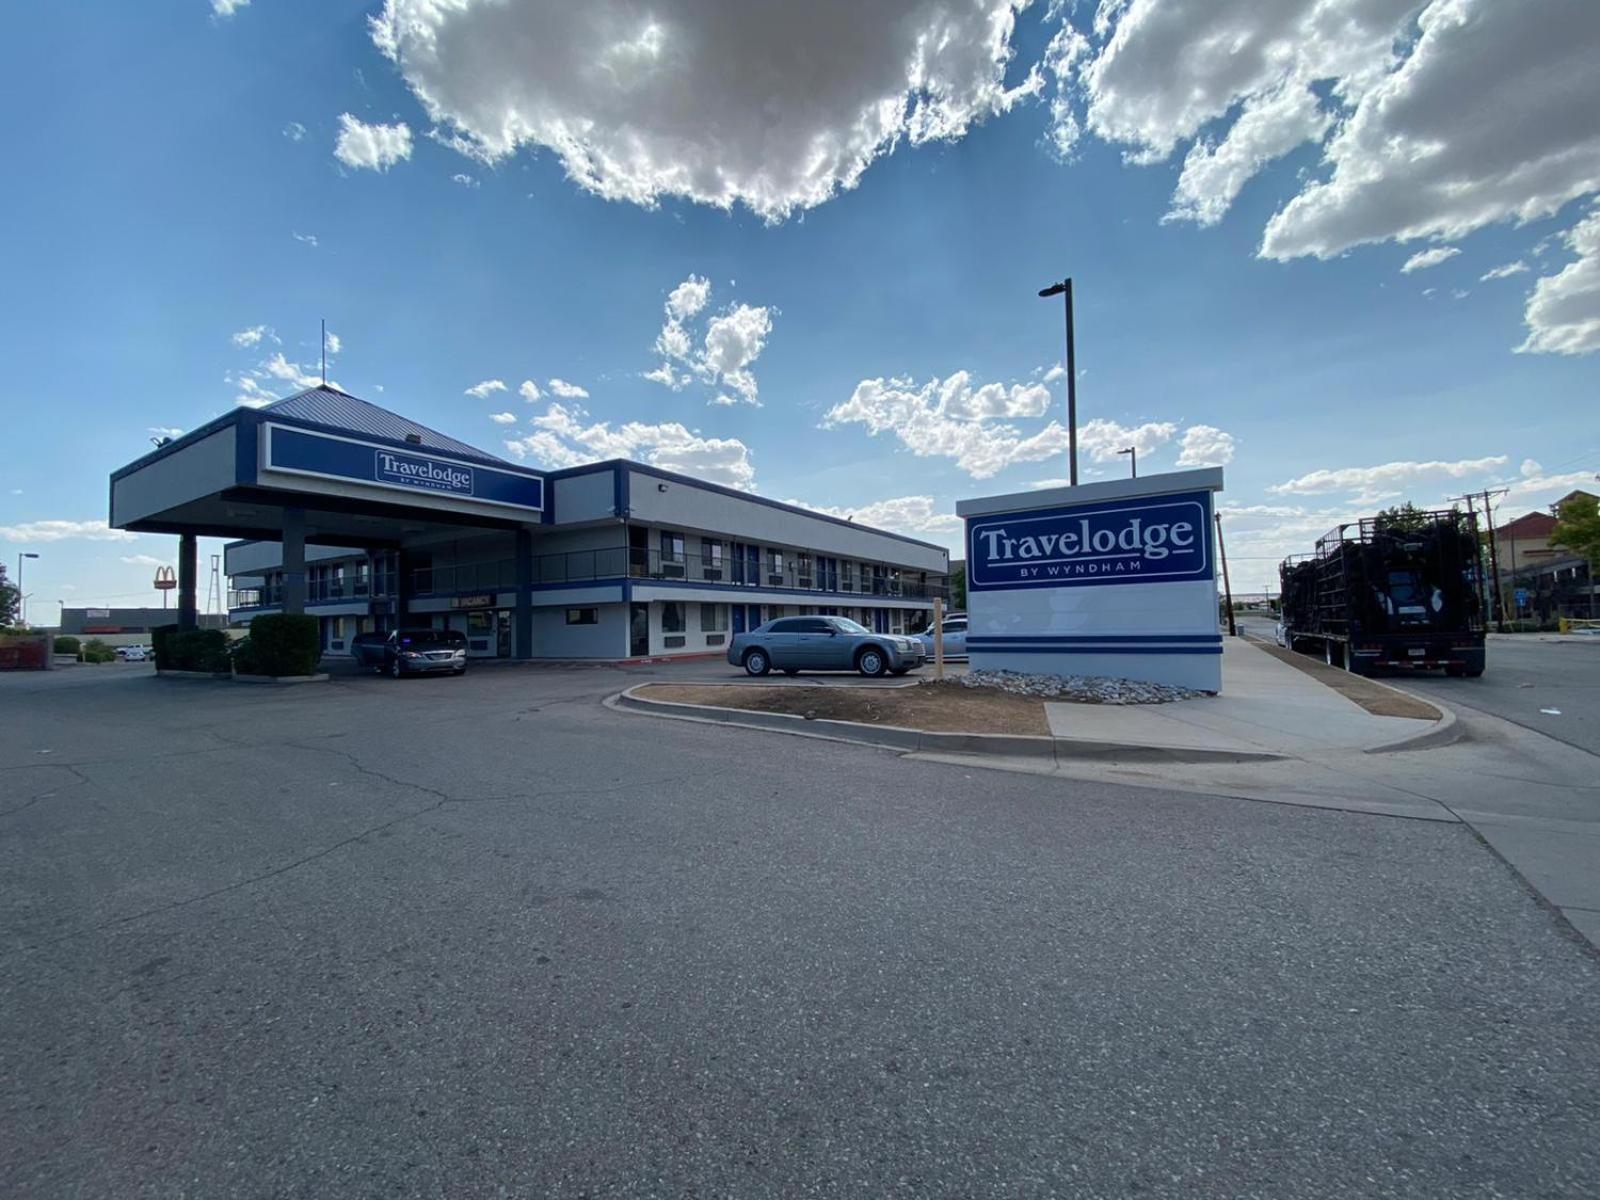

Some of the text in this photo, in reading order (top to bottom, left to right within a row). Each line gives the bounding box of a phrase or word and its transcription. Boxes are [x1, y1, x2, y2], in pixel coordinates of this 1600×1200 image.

[379, 454, 469, 488] Travelodge
[979, 519, 1194, 559] Travelodge
[1020, 560, 1141, 577] BY WYNDHAM
